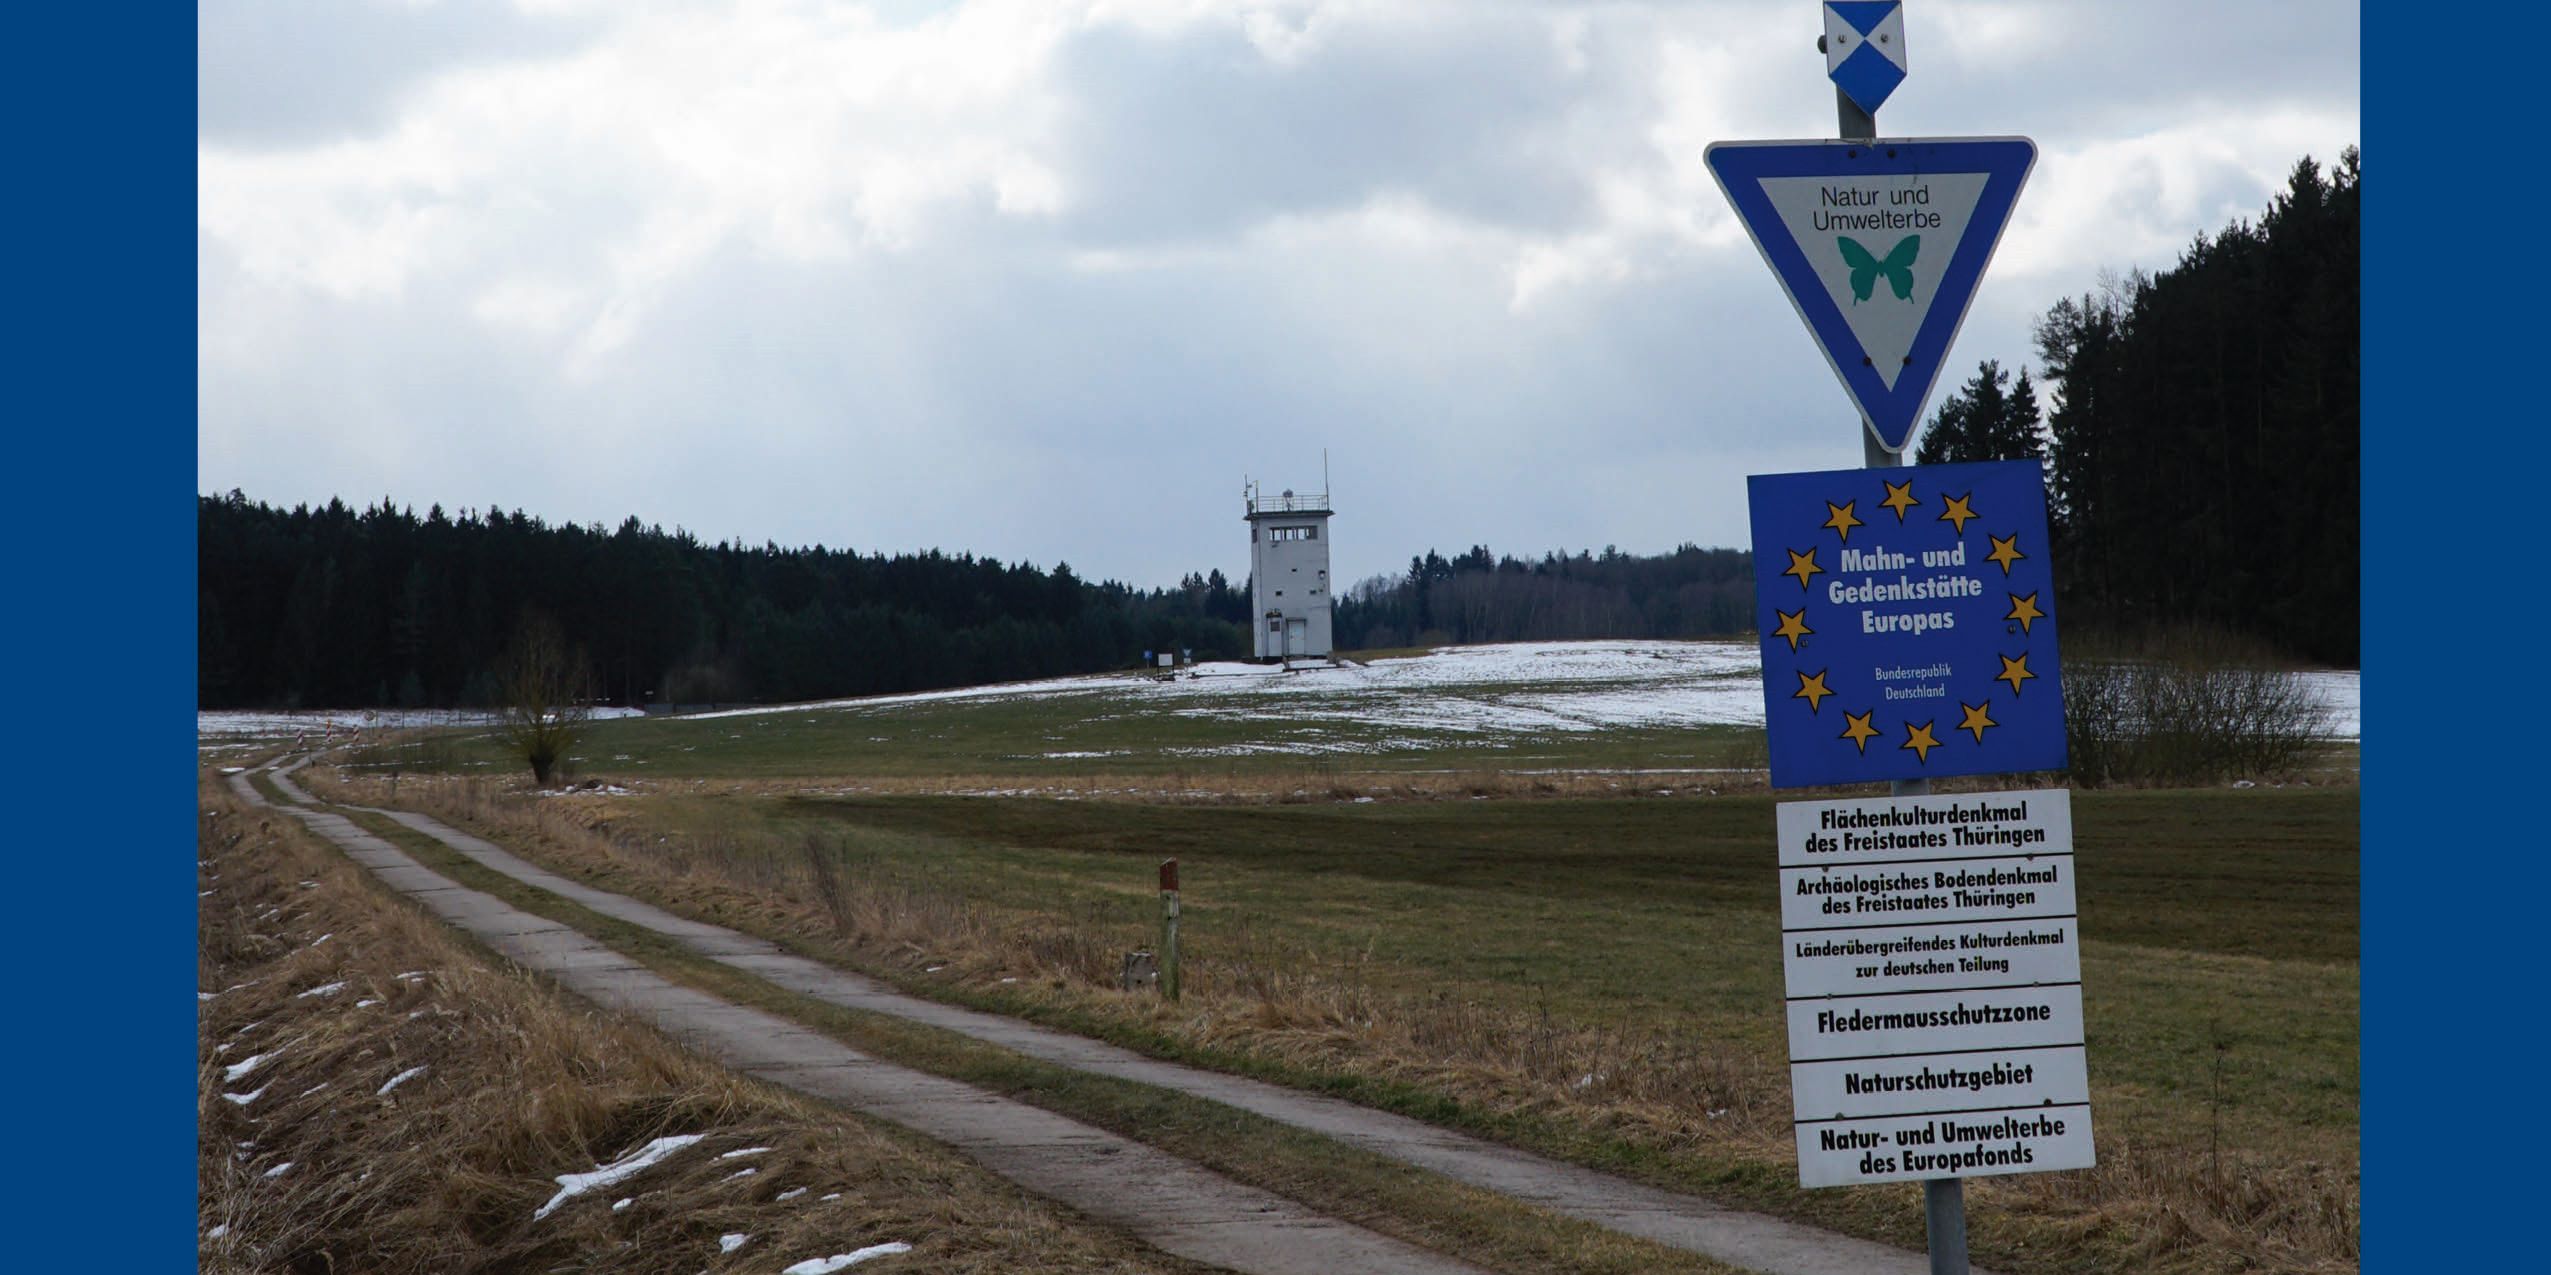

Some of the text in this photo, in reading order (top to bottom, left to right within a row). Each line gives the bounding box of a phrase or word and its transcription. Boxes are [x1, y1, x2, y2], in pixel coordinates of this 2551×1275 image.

[1821, 184, 1929, 207] Natur und
[1813, 208, 1941, 231] Umwelterbe
[1841, 541, 1965, 572] Mahn- und
[1829, 575, 1982, 604] Gedenkstätte
[1862, 610, 1954, 635] Europas
[1875, 663, 1952, 680] Bundesrepublik
[1885, 683, 1945, 700] Deutschland
[1821, 800, 2027, 830] Flächenkulturdenkmal
[1805, 824, 2045, 853] des Freistaates Thüringen
[1797, 865, 2057, 896] Archäologisches Bodendenkmal
[1822, 888, 2035, 914] des Freistaates Thüringen
[1796, 928, 2064, 958] Länderübergreifendes Kulturdenkmal
[1856, 956, 2009, 978] zur deutschen Teilung
[1818, 1003, 2050, 1033] Fledermausschutzzone
[1845, 1062, 2033, 1094] Naturschutzgebiet
[1820, 1114, 2065, 1151] Natur- und Umwelterbe
[1860, 1141, 2033, 1174] des Europafonds
